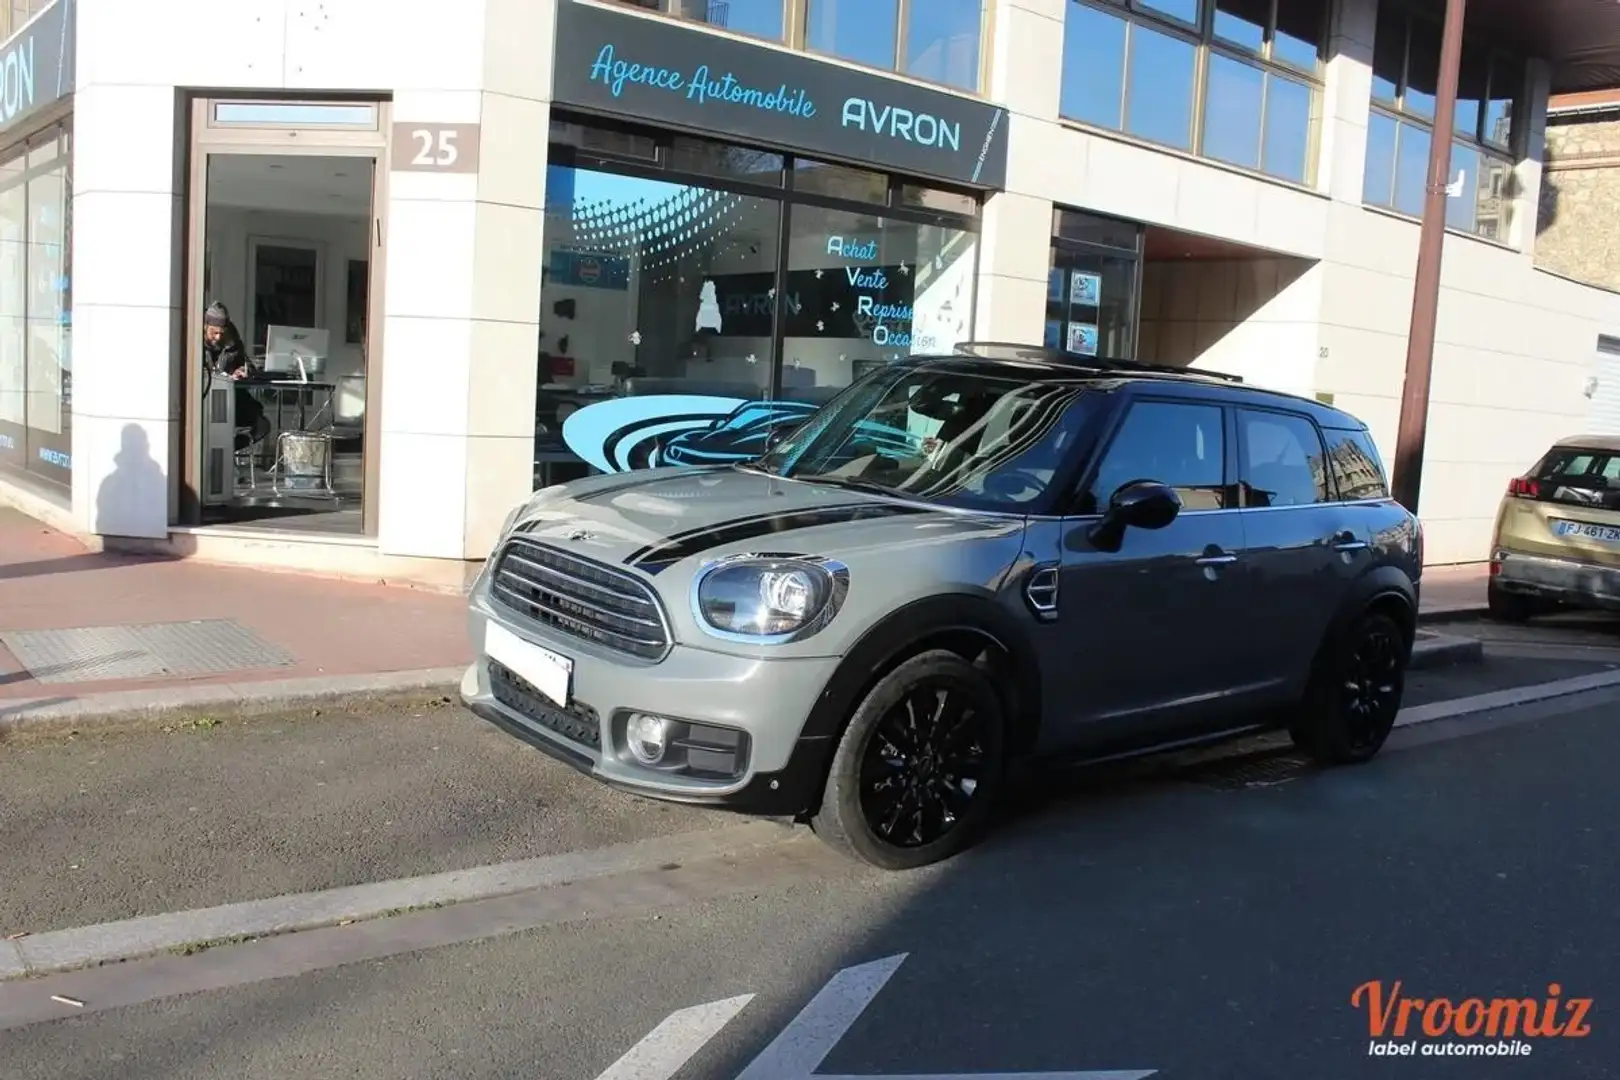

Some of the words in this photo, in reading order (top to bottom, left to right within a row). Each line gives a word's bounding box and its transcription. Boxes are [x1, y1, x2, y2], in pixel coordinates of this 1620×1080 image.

[590, 44, 684, 97] Agence
[686, 65, 817, 118] Automobile
[841, 97, 960, 151] AVRON
[410, 129, 458, 165] 25
[827, 235, 878, 260] Achat
[845, 265, 888, 289] Vente
